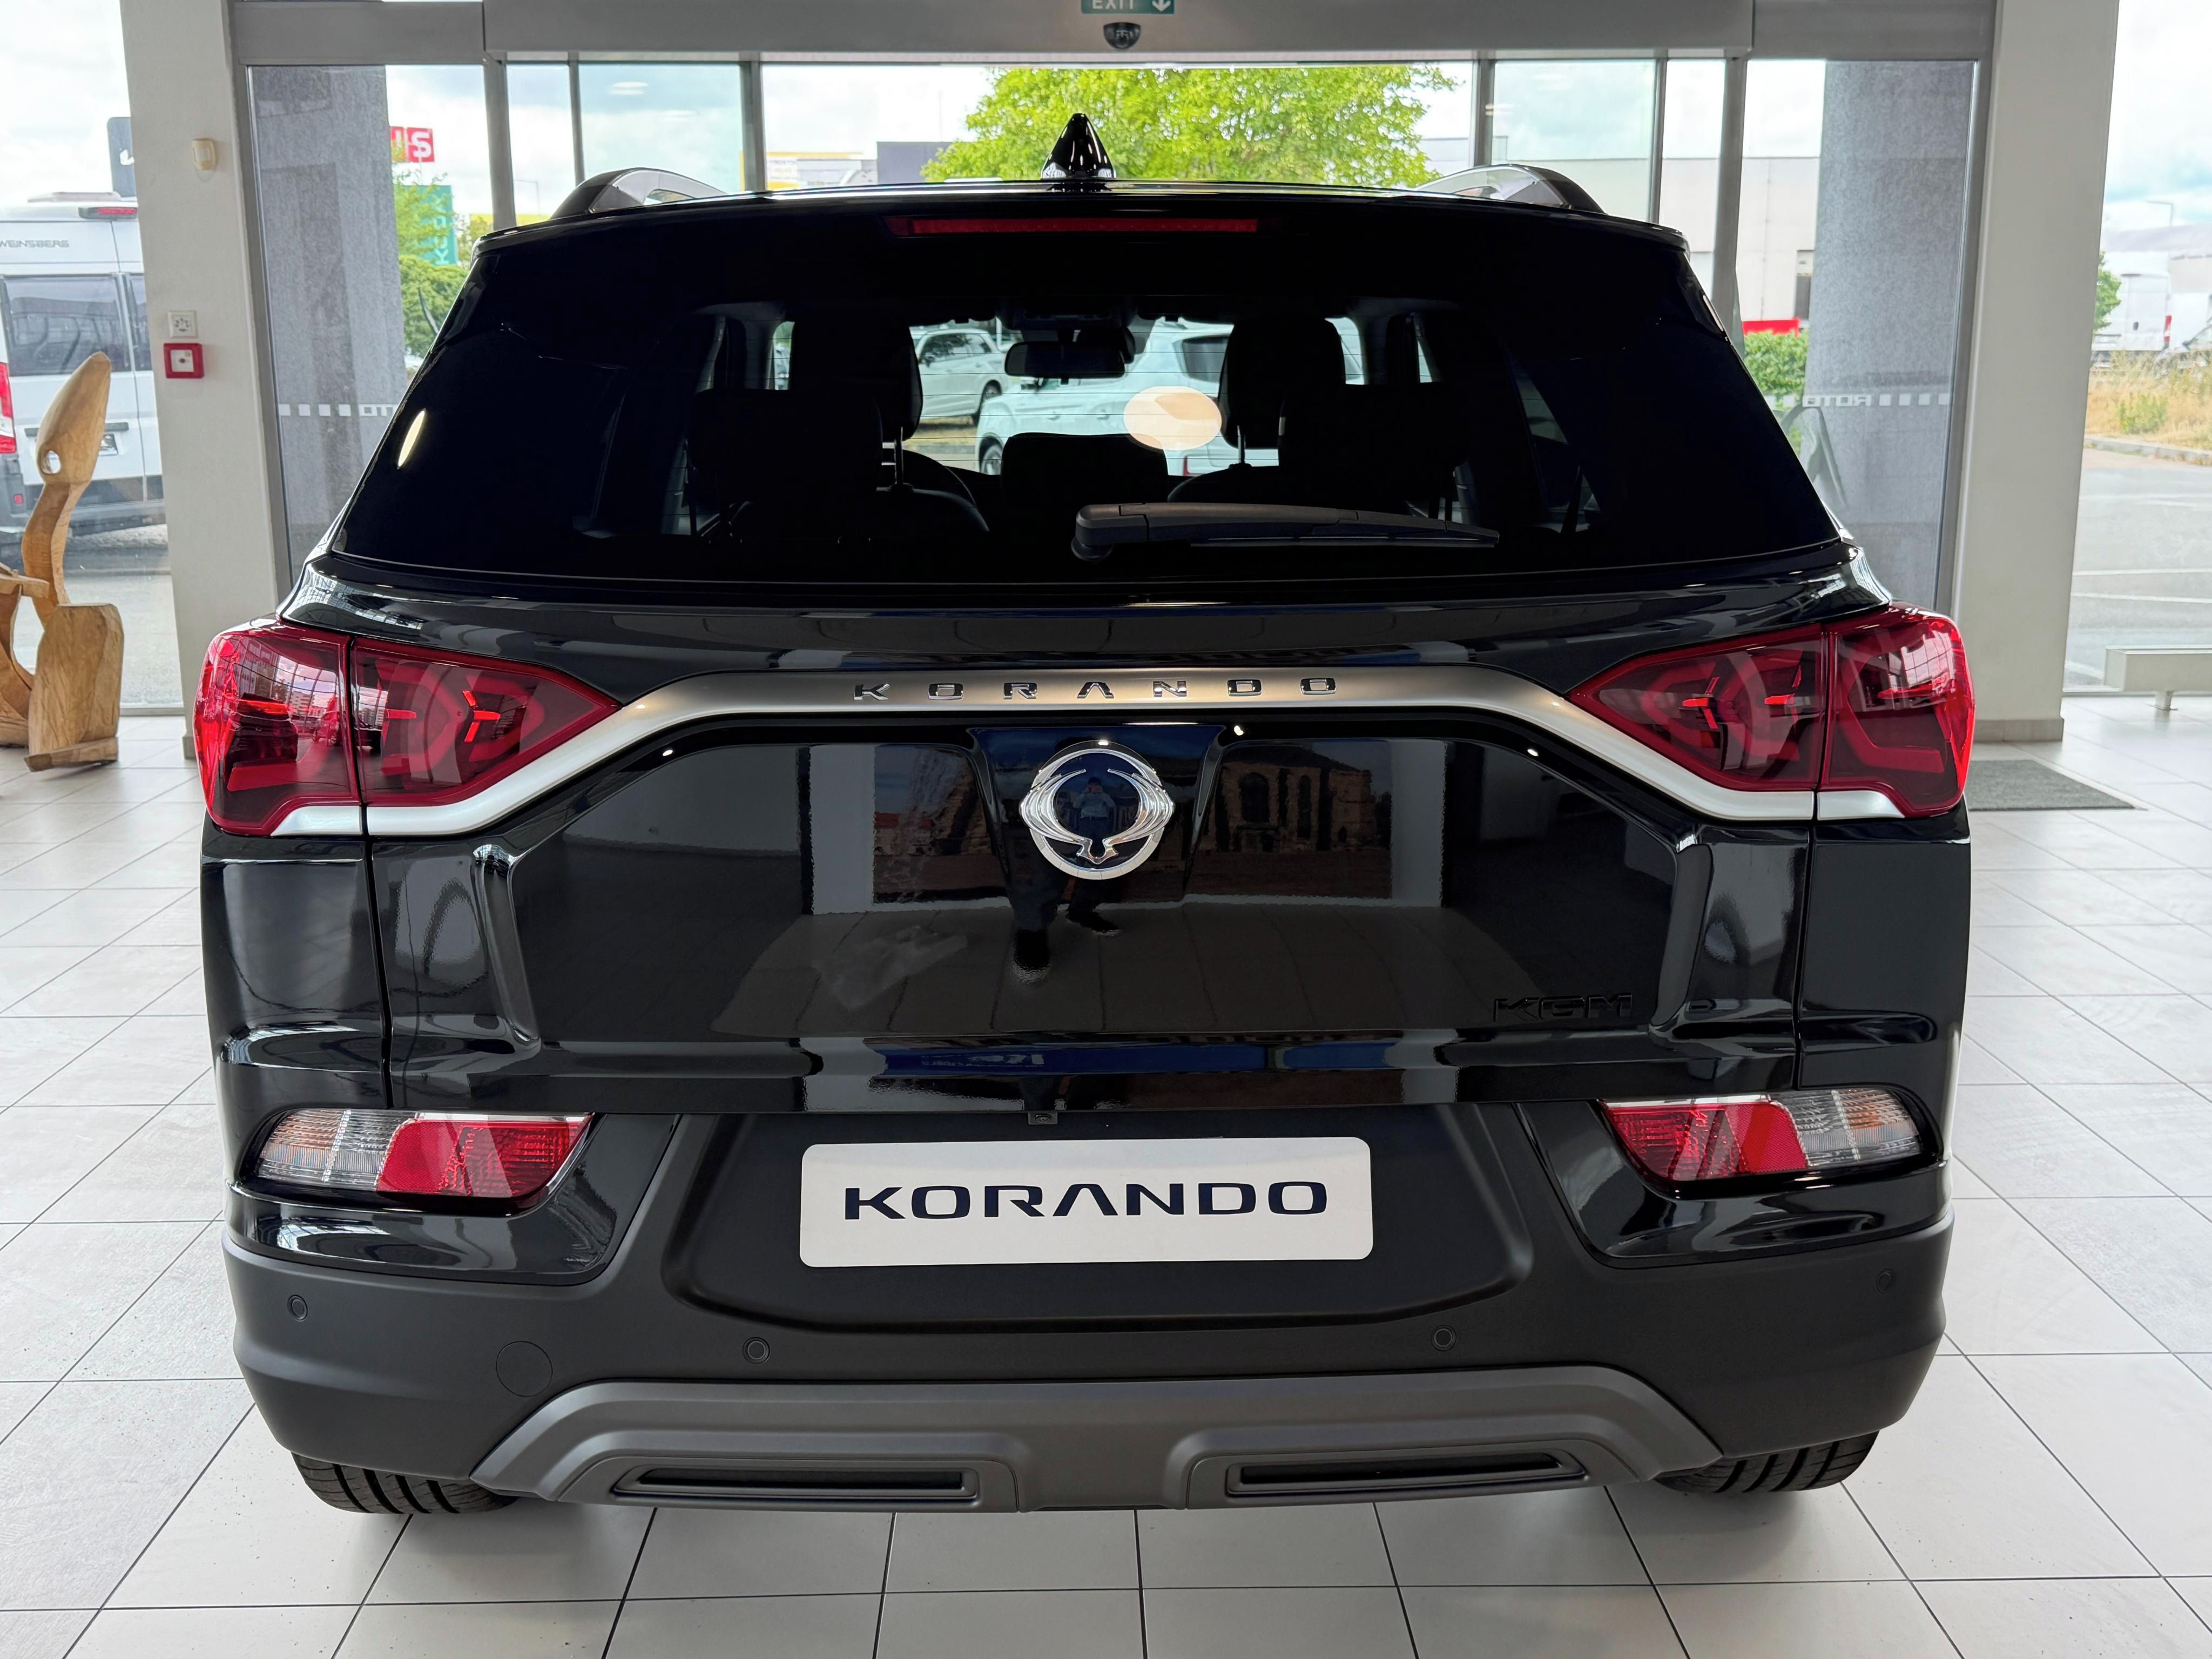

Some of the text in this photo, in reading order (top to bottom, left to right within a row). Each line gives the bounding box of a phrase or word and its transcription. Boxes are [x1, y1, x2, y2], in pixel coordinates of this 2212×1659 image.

[854, 678, 1337, 700] KORANDO
[1493, 994, 1632, 1022] KGM
[845, 1181, 1327, 1220] KORANDO
